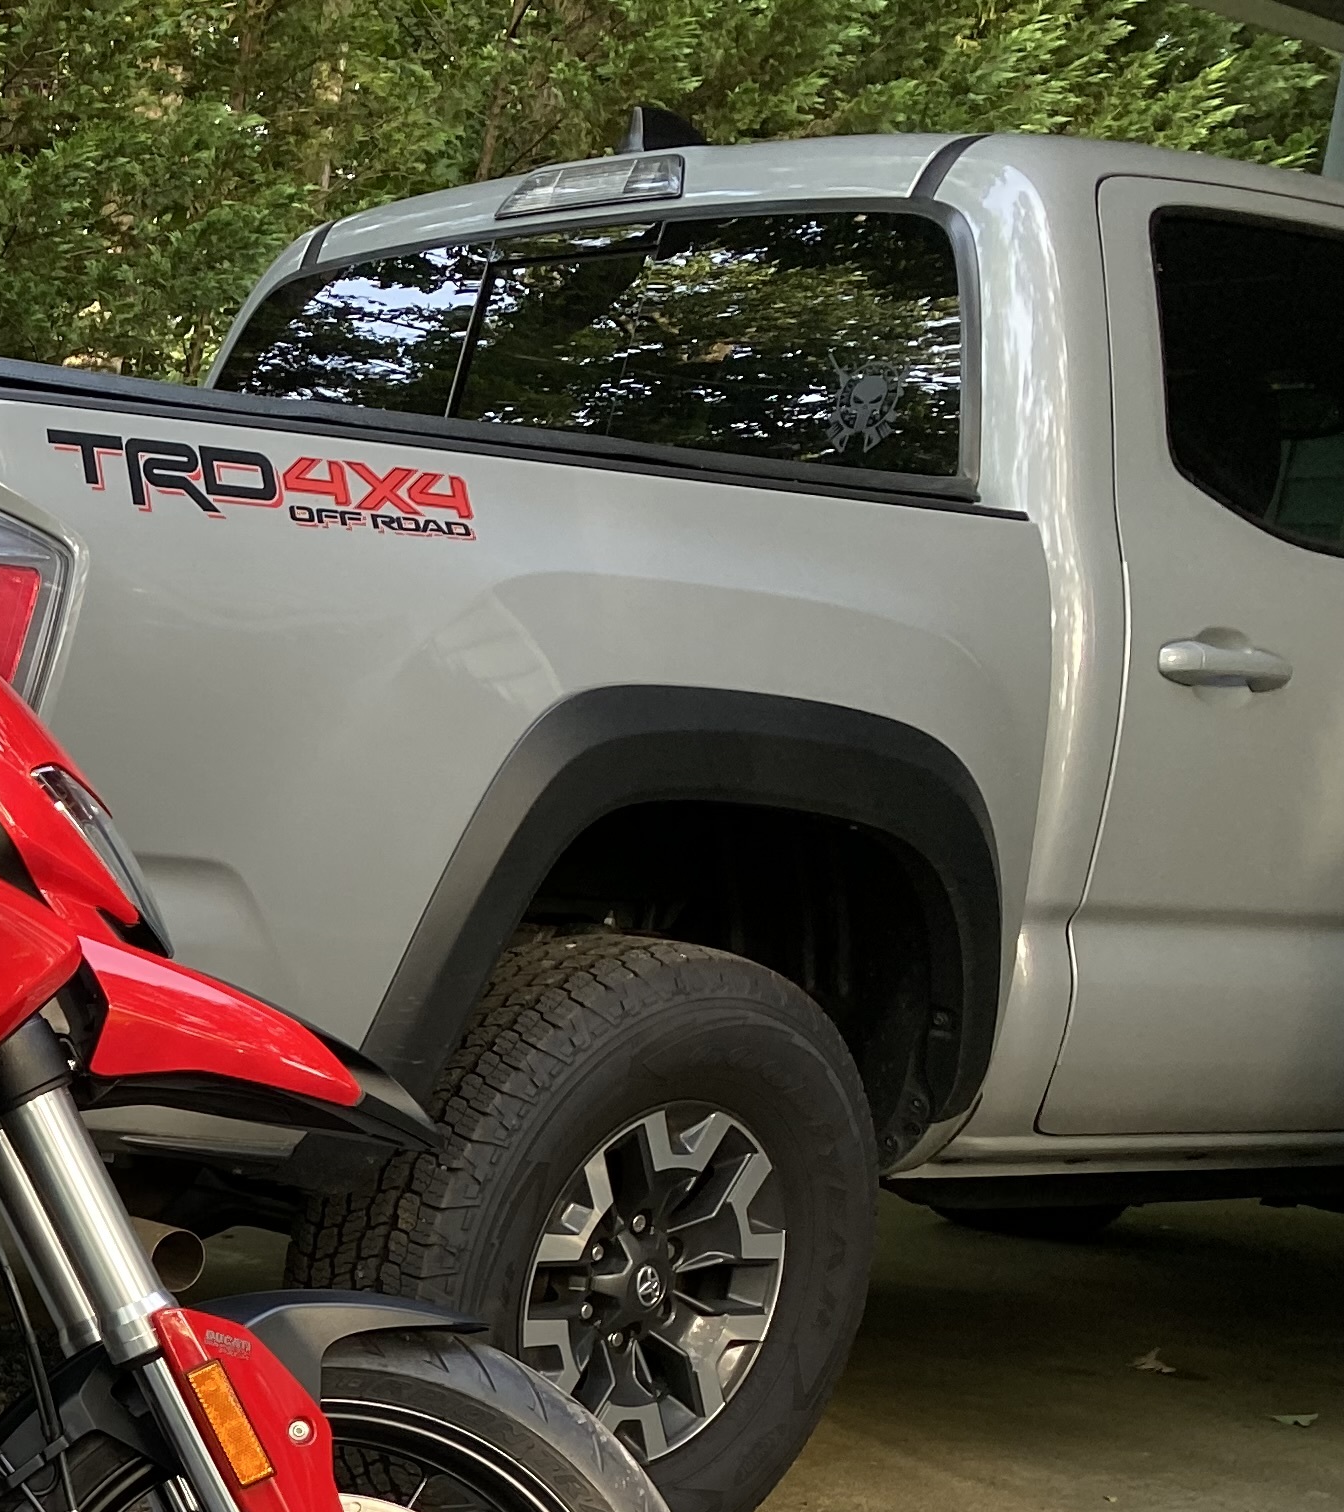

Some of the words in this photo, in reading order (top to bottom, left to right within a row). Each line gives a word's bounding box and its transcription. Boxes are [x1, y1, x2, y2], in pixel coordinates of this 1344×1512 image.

[46, 428, 282, 519] TRD
[282, 456, 474, 520] 4X4
[288, 505, 367, 531] OFF
[370, 513, 477, 540] ROAD
